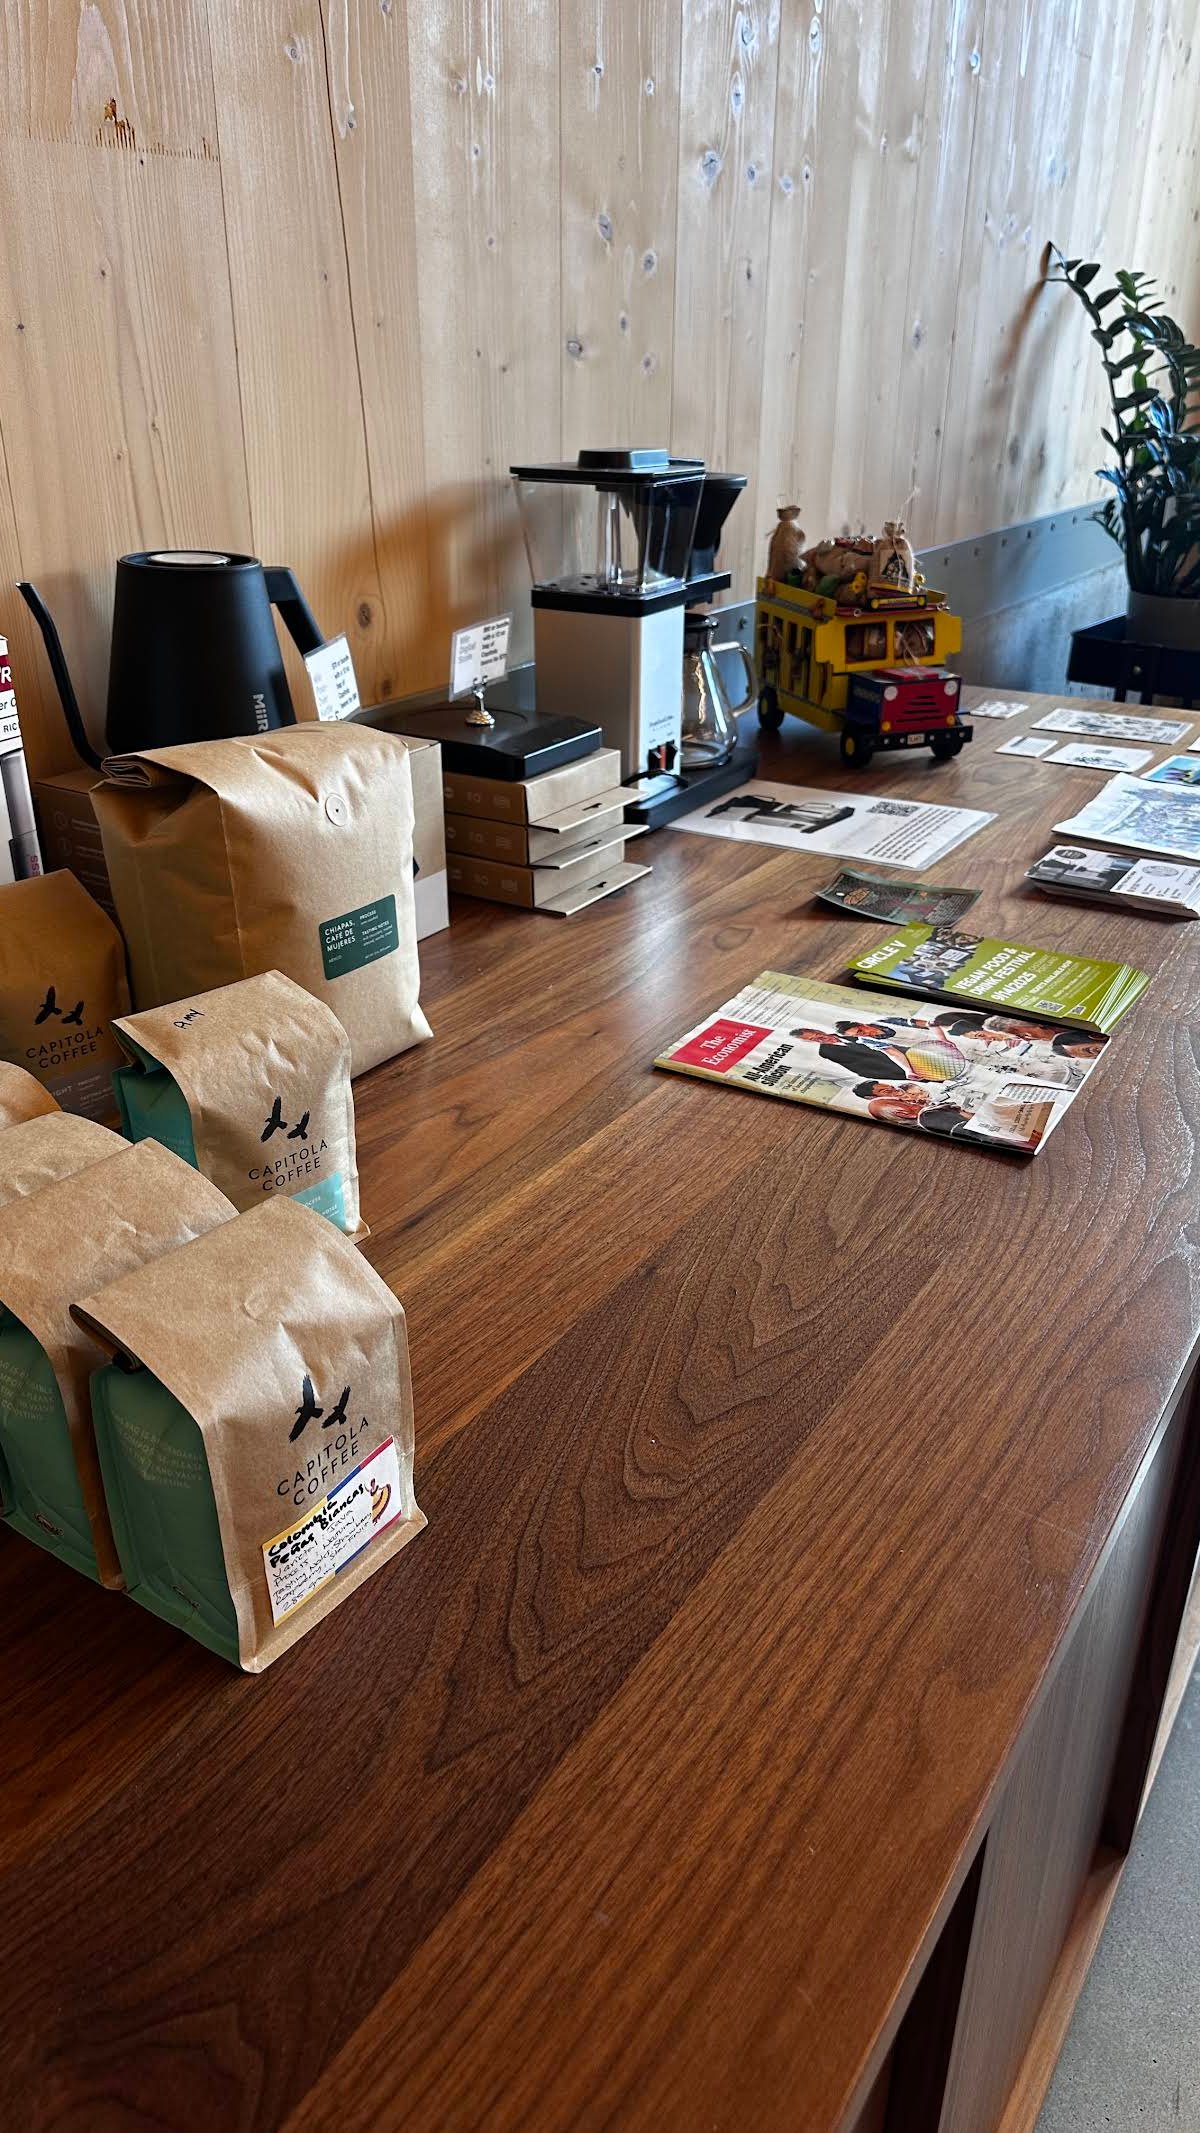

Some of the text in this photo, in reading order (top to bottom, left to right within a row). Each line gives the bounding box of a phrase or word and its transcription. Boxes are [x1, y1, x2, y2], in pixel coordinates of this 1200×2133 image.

[326, 935, 356, 952] MUJERES
[344, 927, 354, 937] DE
[856, 946, 899, 969] CIRCLE
[952, 969, 989, 990] VEGAN
[982, 953, 1012, 972] FOOD
[968, 976, 1002, 996] DRINK
[994, 951, 1037, 980] FESTIVAL
[26, 1026, 104, 1060] CAPITOLA
[39, 1041, 97, 1069] COFFEE
[699, 1035, 727, 1050] The
[700, 1029, 757, 1066] Economist
[741, 1043, 795, 1082] All-American
[760, 1064, 793, 1087] silicon
[53, 1085, 73, 1097] IGHT
[248, 1139, 328, 1180] CAPITOLA
[262, 1156, 321, 1191] COFFEE
[277, 1416, 369, 1497] CAPITOLA
[293, 1441, 359, 1506] COFFEE
